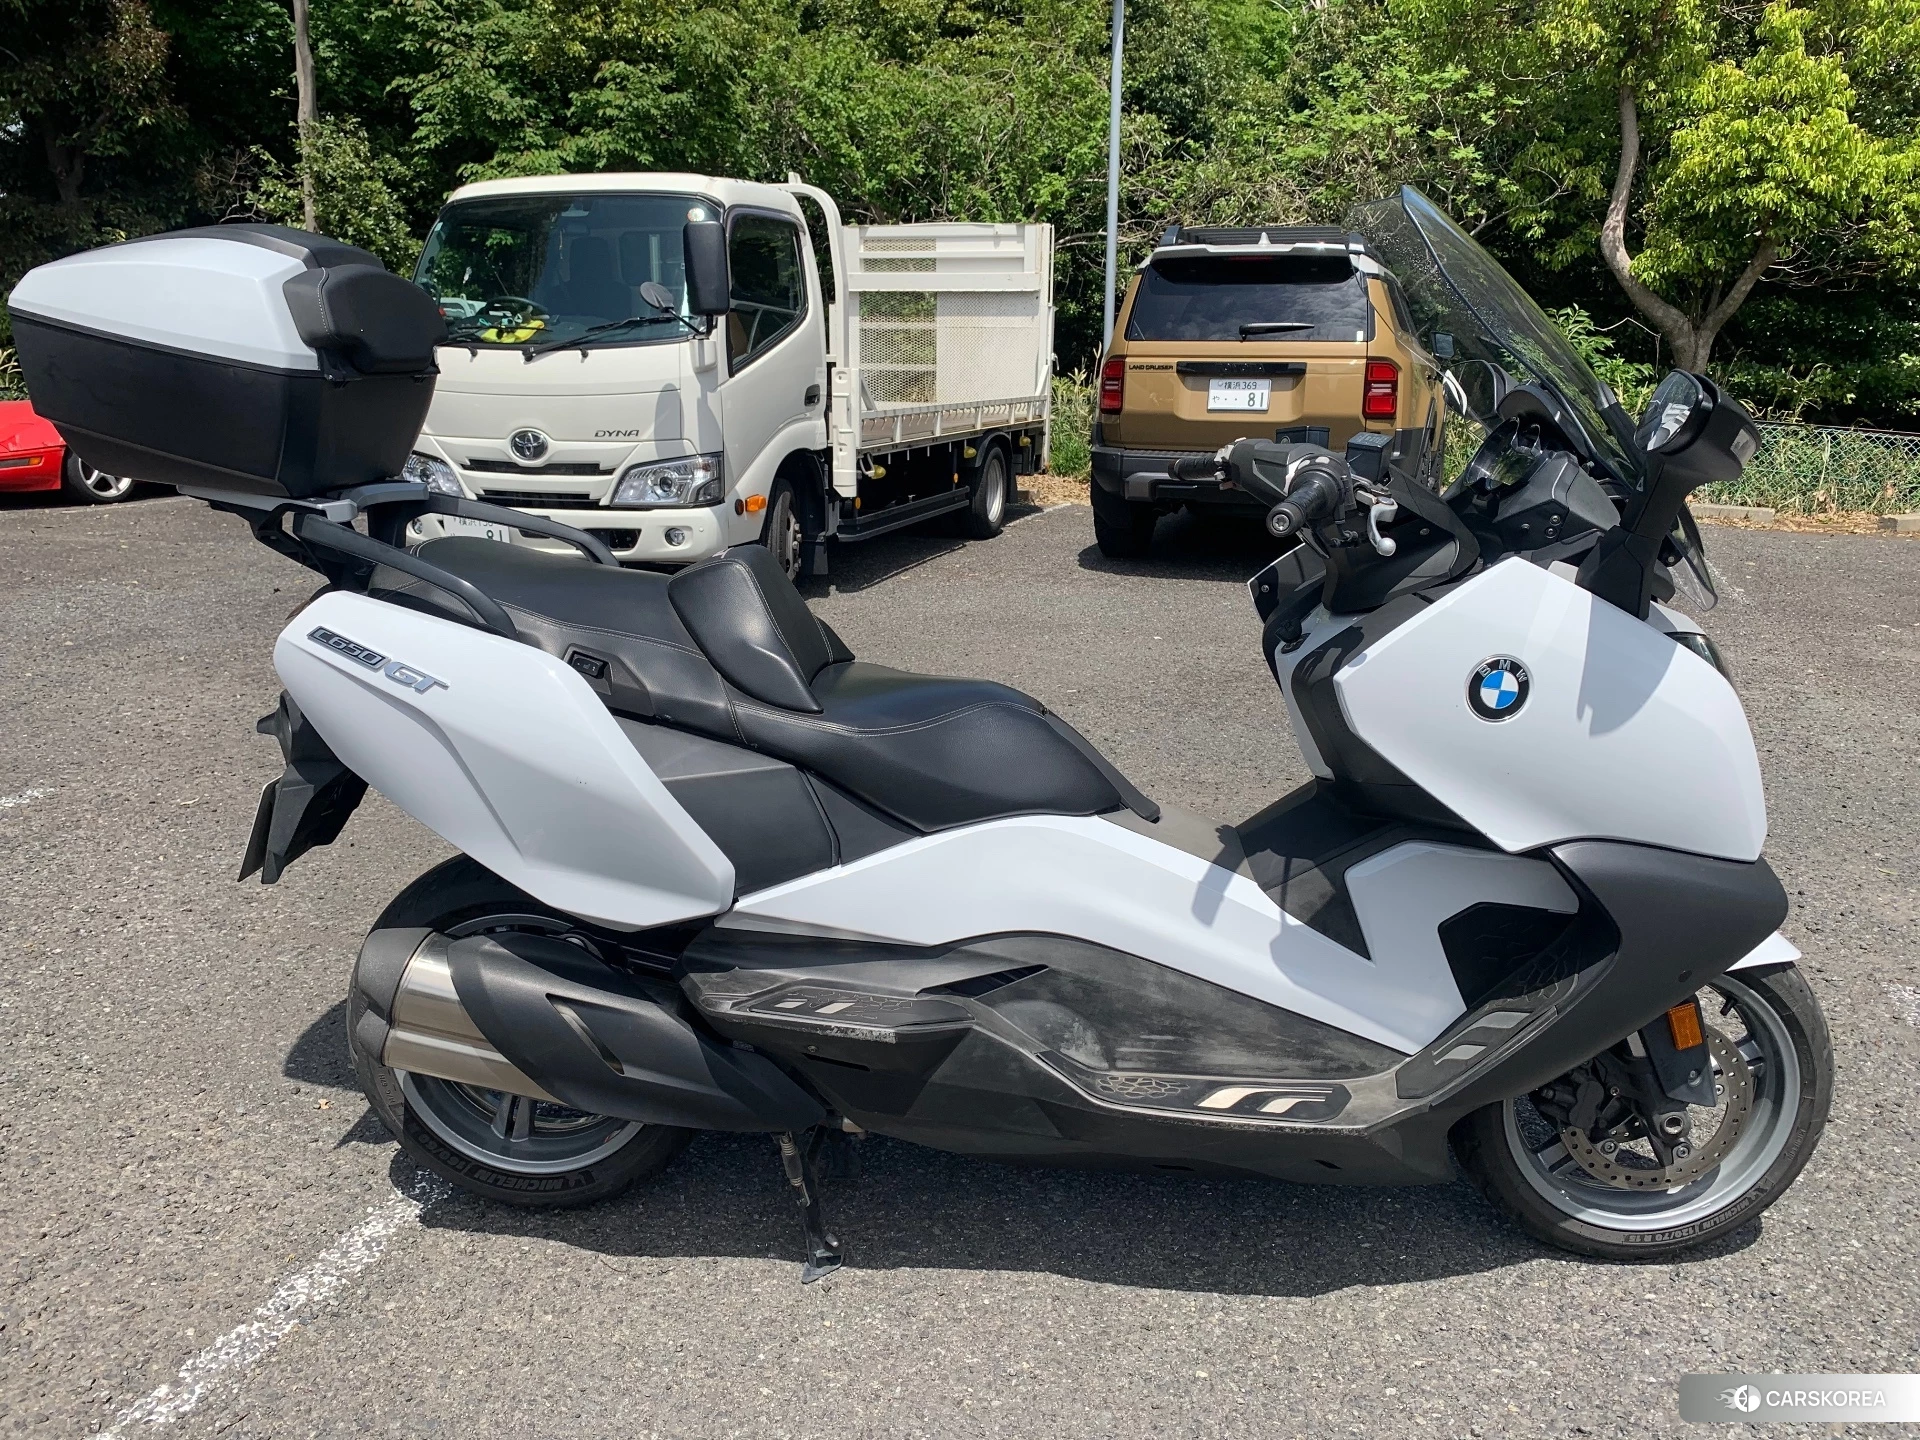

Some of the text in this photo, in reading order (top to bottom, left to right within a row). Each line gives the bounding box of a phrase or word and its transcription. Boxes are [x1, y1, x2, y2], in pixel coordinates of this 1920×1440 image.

[1224, 381, 1258, 390] 横浜 369
[1247, 392, 1264, 408] 81
[594, 429, 640, 438] DYNA
[383, 661, 450, 695] GT
[1477, 659, 1528, 683] BMW
[474, 1168, 565, 1191] MICHELIN
[1702, 1198, 1751, 1230] MICHELIN
[1627, 1233, 1642, 1243] 15
[1655, 1225, 1696, 1242] 120/70
